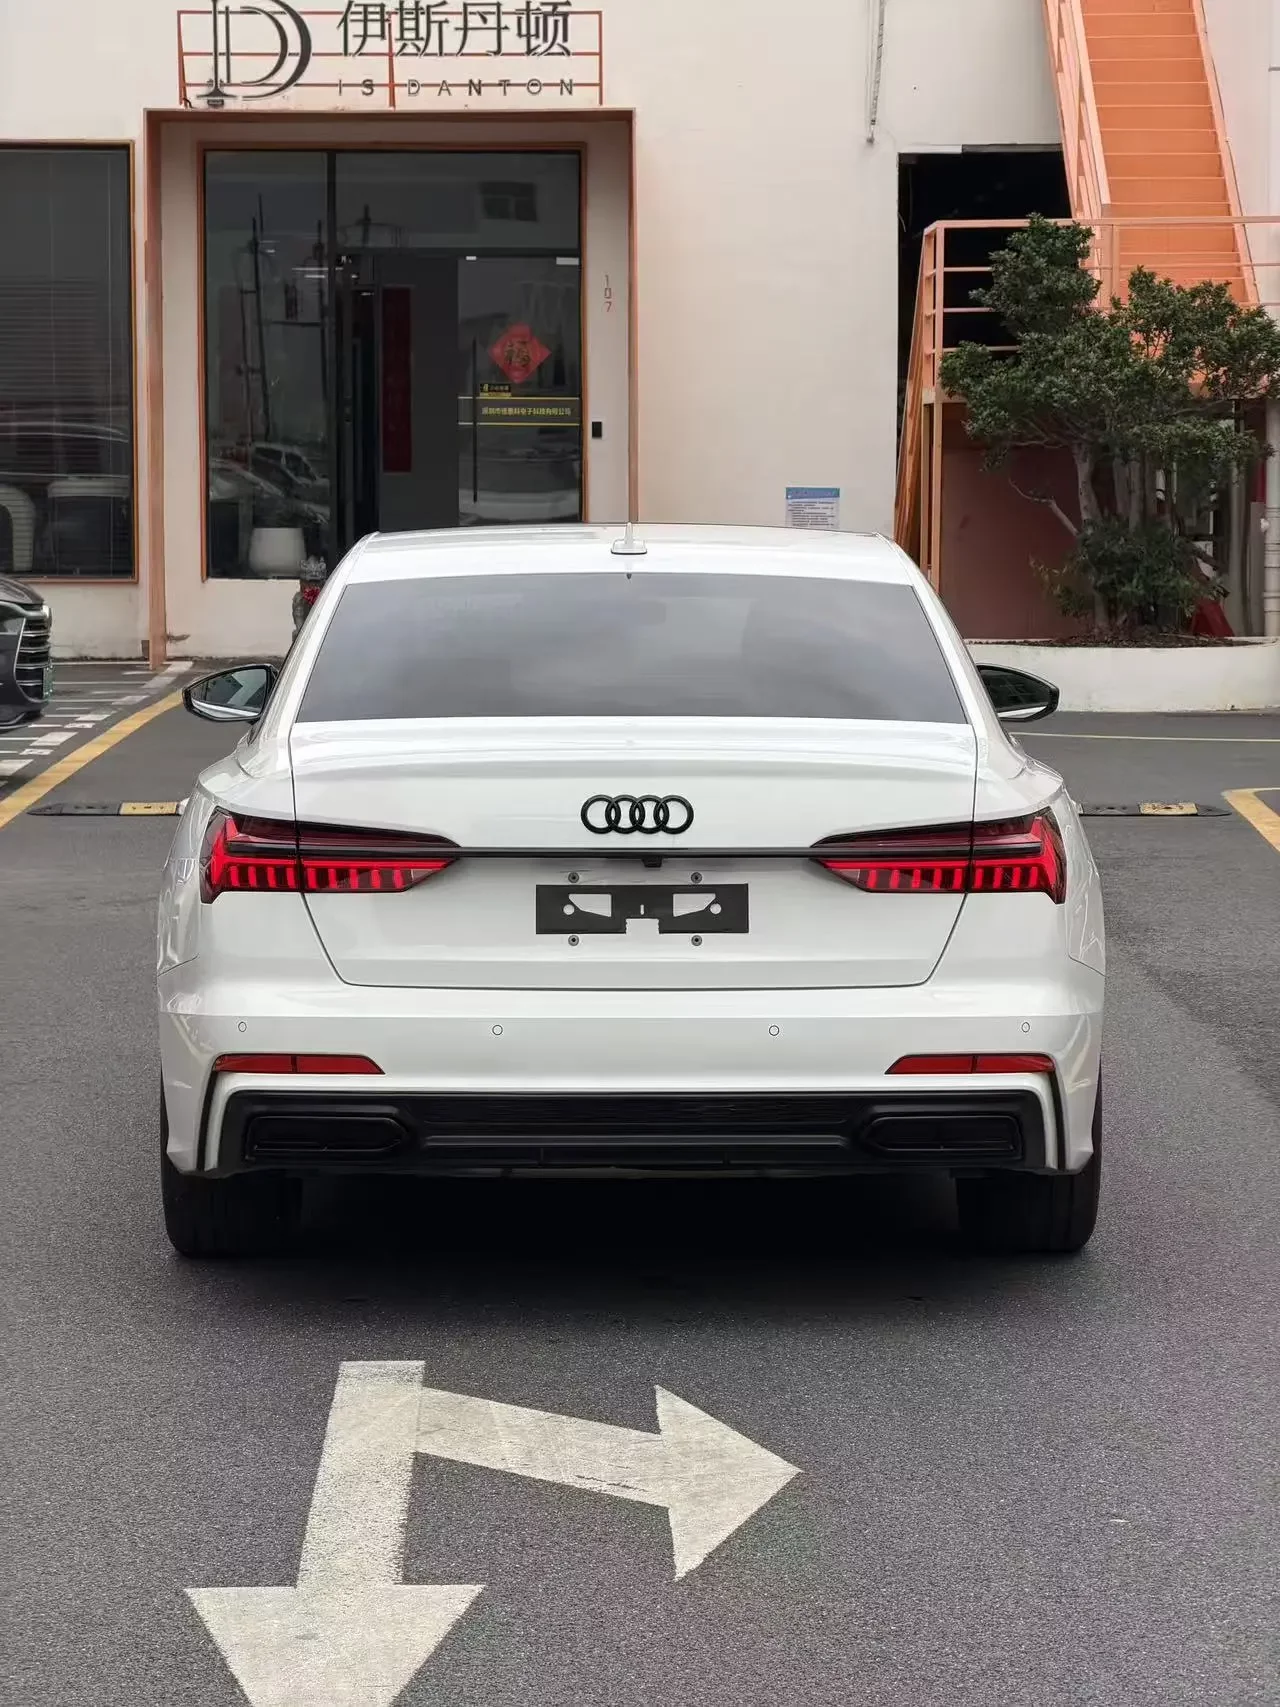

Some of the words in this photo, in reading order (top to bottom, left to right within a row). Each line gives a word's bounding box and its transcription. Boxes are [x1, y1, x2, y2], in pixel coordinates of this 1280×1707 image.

[336, 0, 573, 57] 伊斯丹顿
[603, 274, 613, 313] 107
[503, 340, 532, 368] 福
